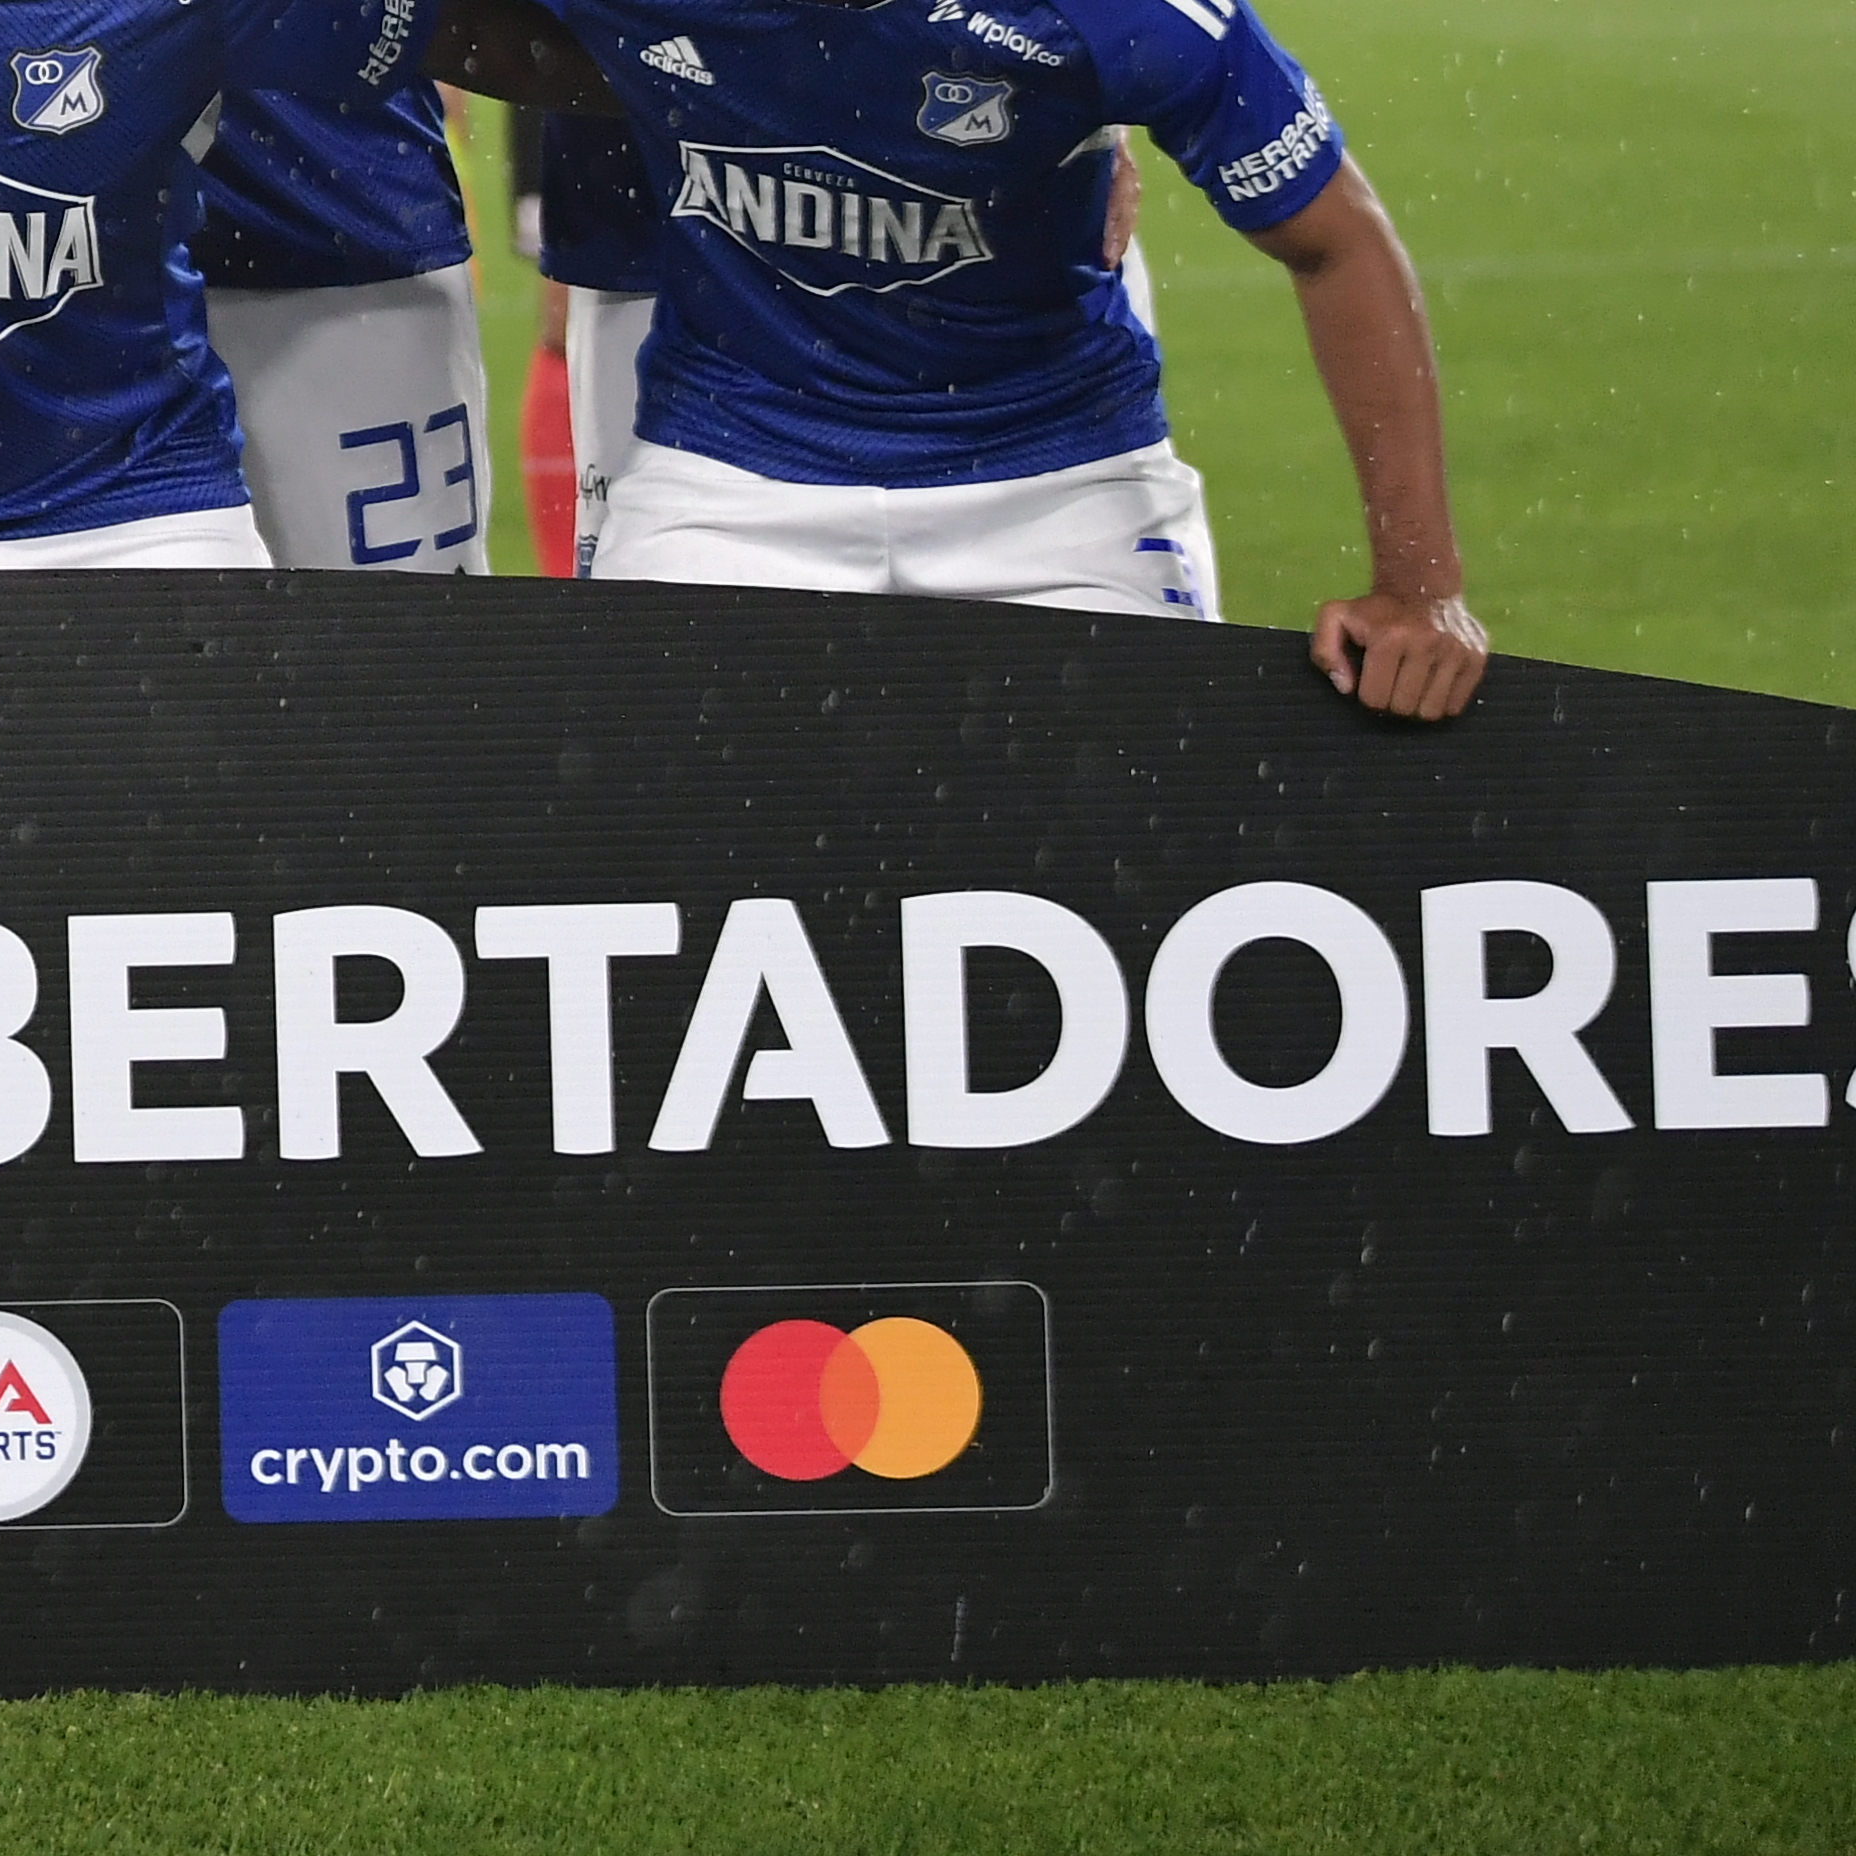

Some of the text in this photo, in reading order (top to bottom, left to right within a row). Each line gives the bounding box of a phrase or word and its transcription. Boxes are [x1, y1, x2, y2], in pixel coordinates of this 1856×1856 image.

[640, 48, 715, 86] adidas
[967, 11, 1062, 67] Wplay.co
[783, 162, 856, 189] CERVEZA
[684, 150, 986, 265] ANDINA
[338, 402, 479, 567] 23
[250, 1437, 590, 1494] crypto.com
